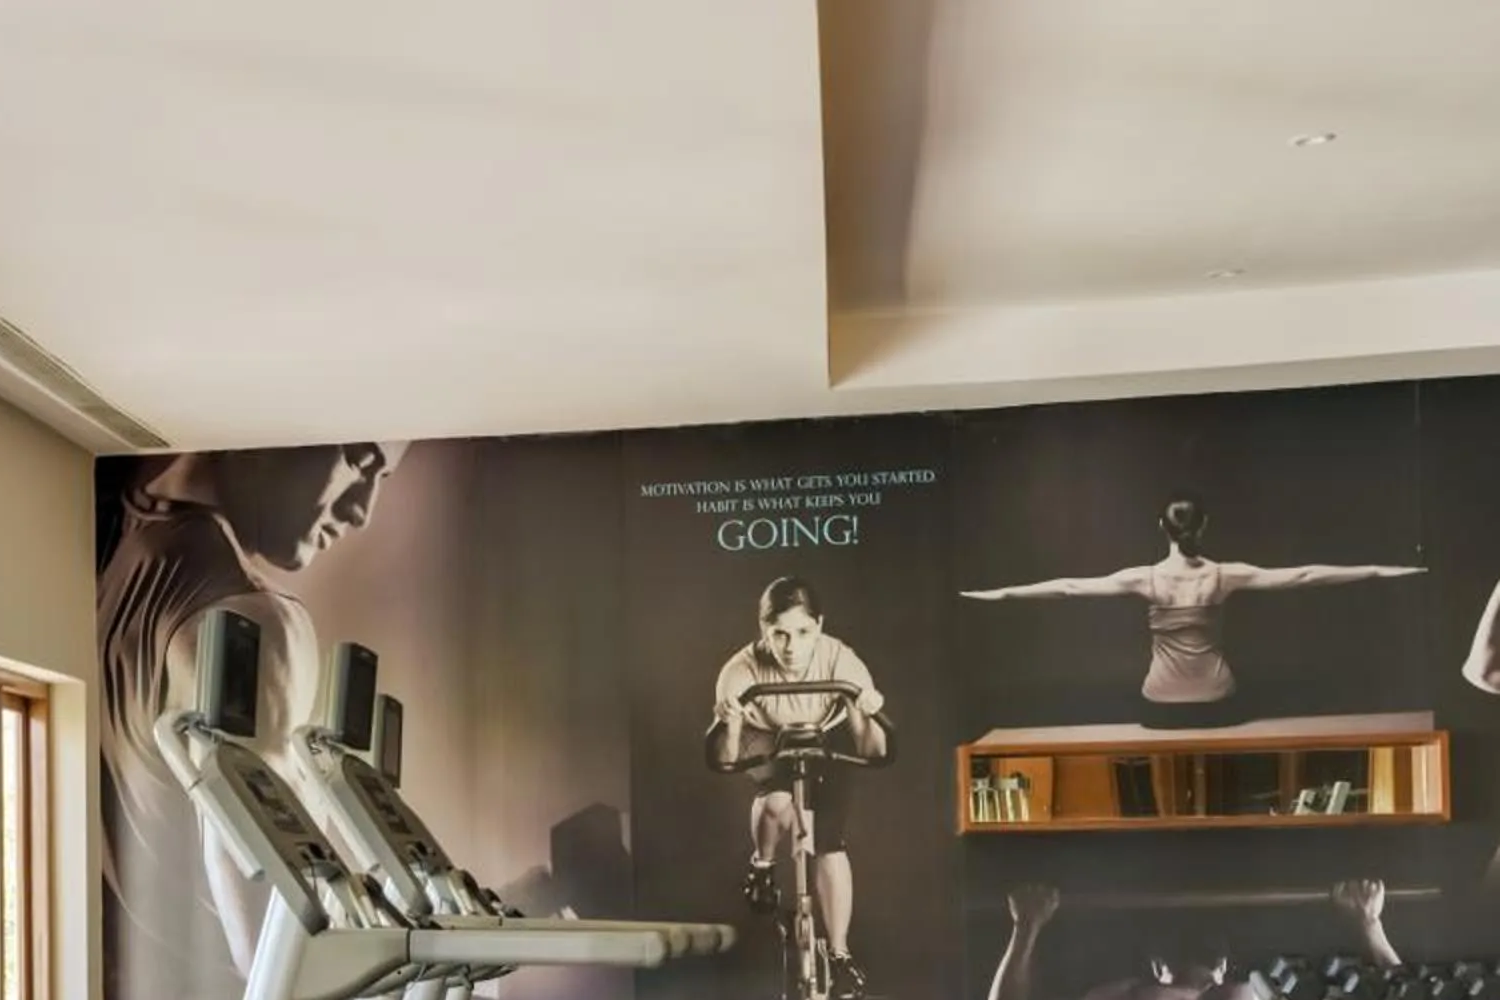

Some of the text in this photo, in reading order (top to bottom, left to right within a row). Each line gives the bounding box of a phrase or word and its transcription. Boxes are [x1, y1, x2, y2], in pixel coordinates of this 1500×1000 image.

[640, 469, 936, 497] MOTIVATION IS WHAT GETS YOU STARTED
[696, 492, 881, 513] HABIT IS WHAT KEEPS YOU
[717, 514, 859, 551] GOING!
